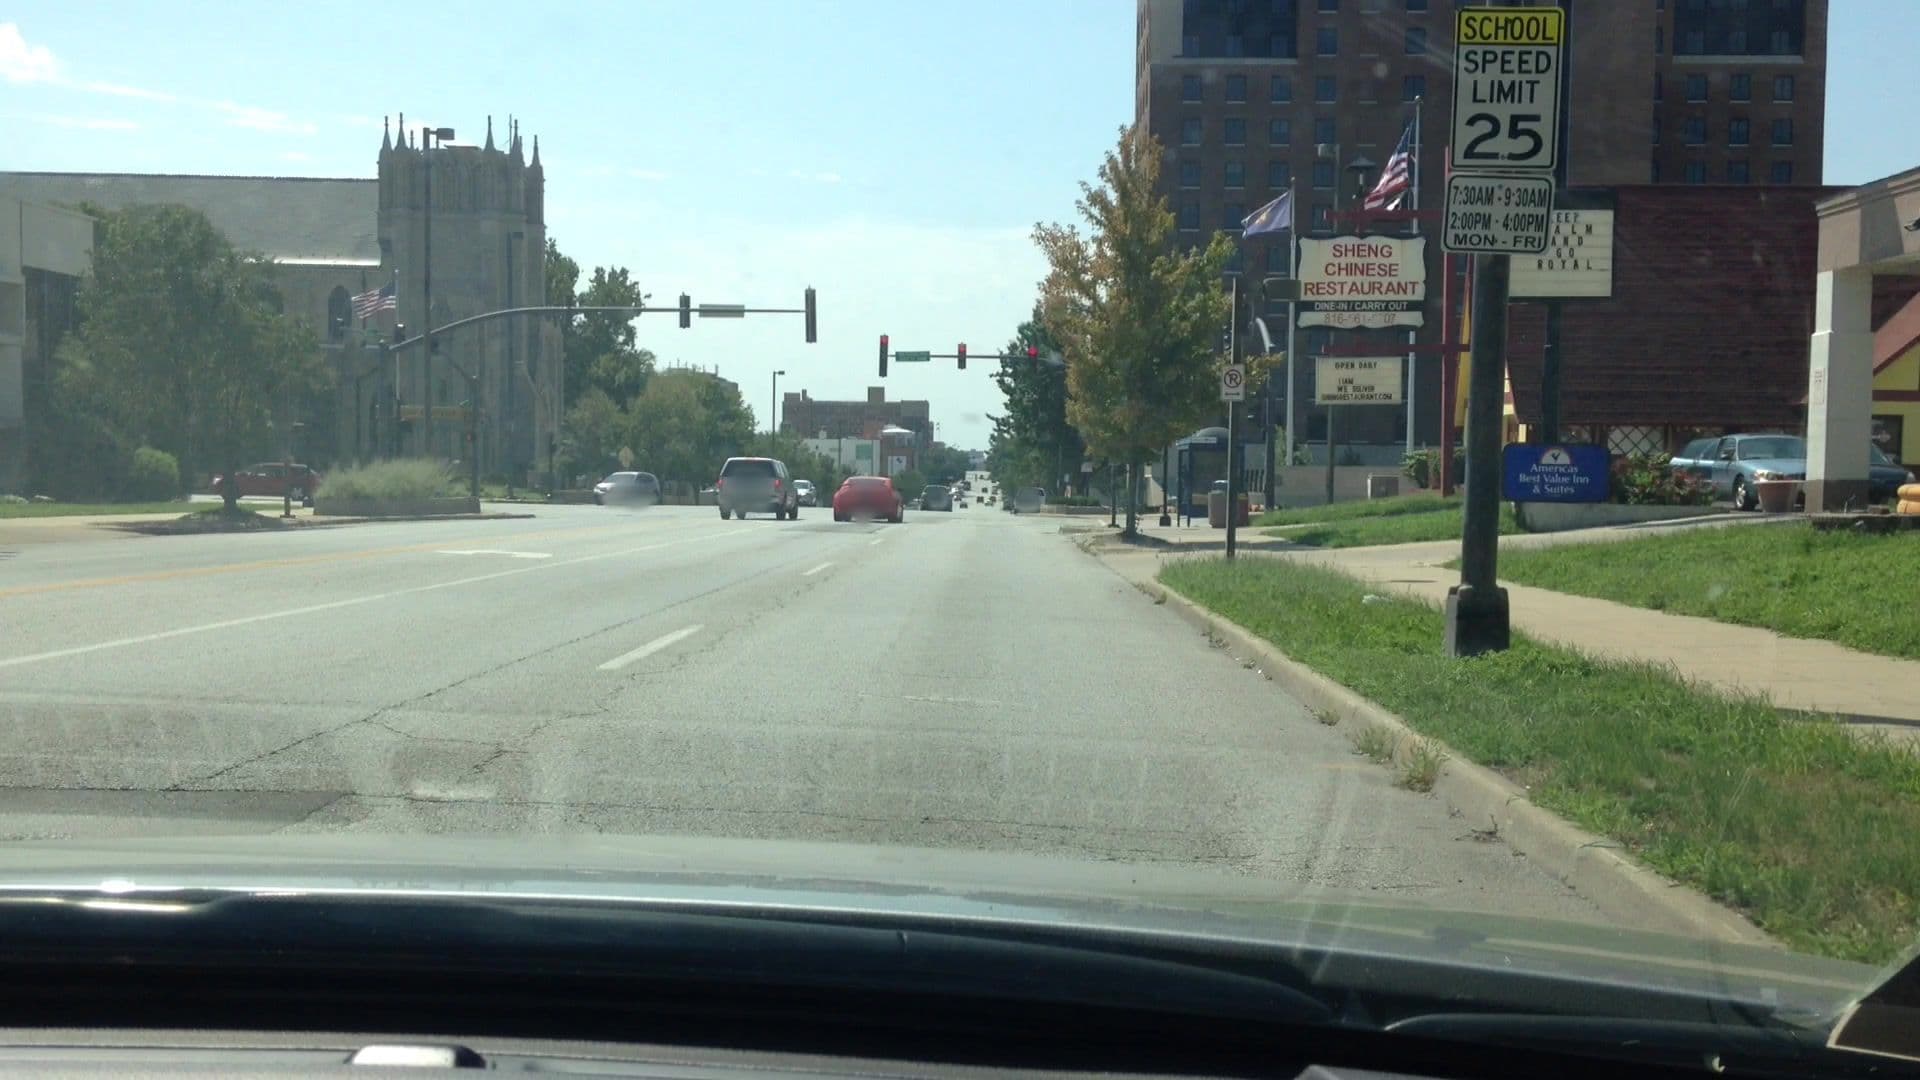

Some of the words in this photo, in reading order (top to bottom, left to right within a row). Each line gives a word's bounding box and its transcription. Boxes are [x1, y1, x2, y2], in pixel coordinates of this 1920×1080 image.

[1463, 16, 1554, 41] SCHOOL
[1463, 50, 1552, 74] SPEED
[1472, 79, 1540, 104] LIMIT
[1463, 113, 1544, 161] 25
[1452, 186, 1495, 206] 7:30AM
[1504, 187, 1548, 208] 9:30AM
[1450, 212, 1492, 231] 2:00PM
[1502, 213, 1545, 233] 4:00PM
[1453, 233, 1496, 246] MON
[1513, 235, 1543, 249] FRI
[1551, 236, 1584, 247] AND
[1332, 243, 1393, 258] SHENG
[1324, 262, 1400, 278] CHINESE
[1537, 260, 1593, 270] ROYAL
[1303, 281, 1420, 296] RESTAURANT
[1314, 302, 1348, 311] DINE-IN
[1354, 302, 1387, 311] CARRY
[1388, 301, 1409, 311] OUT
[1335, 362, 1355, 370] OPEN
[1358, 361, 1378, 369] DAILY
[1530, 463, 1579, 473] Americas
[1519, 473, 1540, 483] Best
[1543, 473, 1570, 484] Value
[1572, 475, 1590, 484] Inn
[1532, 485, 1540, 494] &
[1544, 484, 1576, 494] Suites
